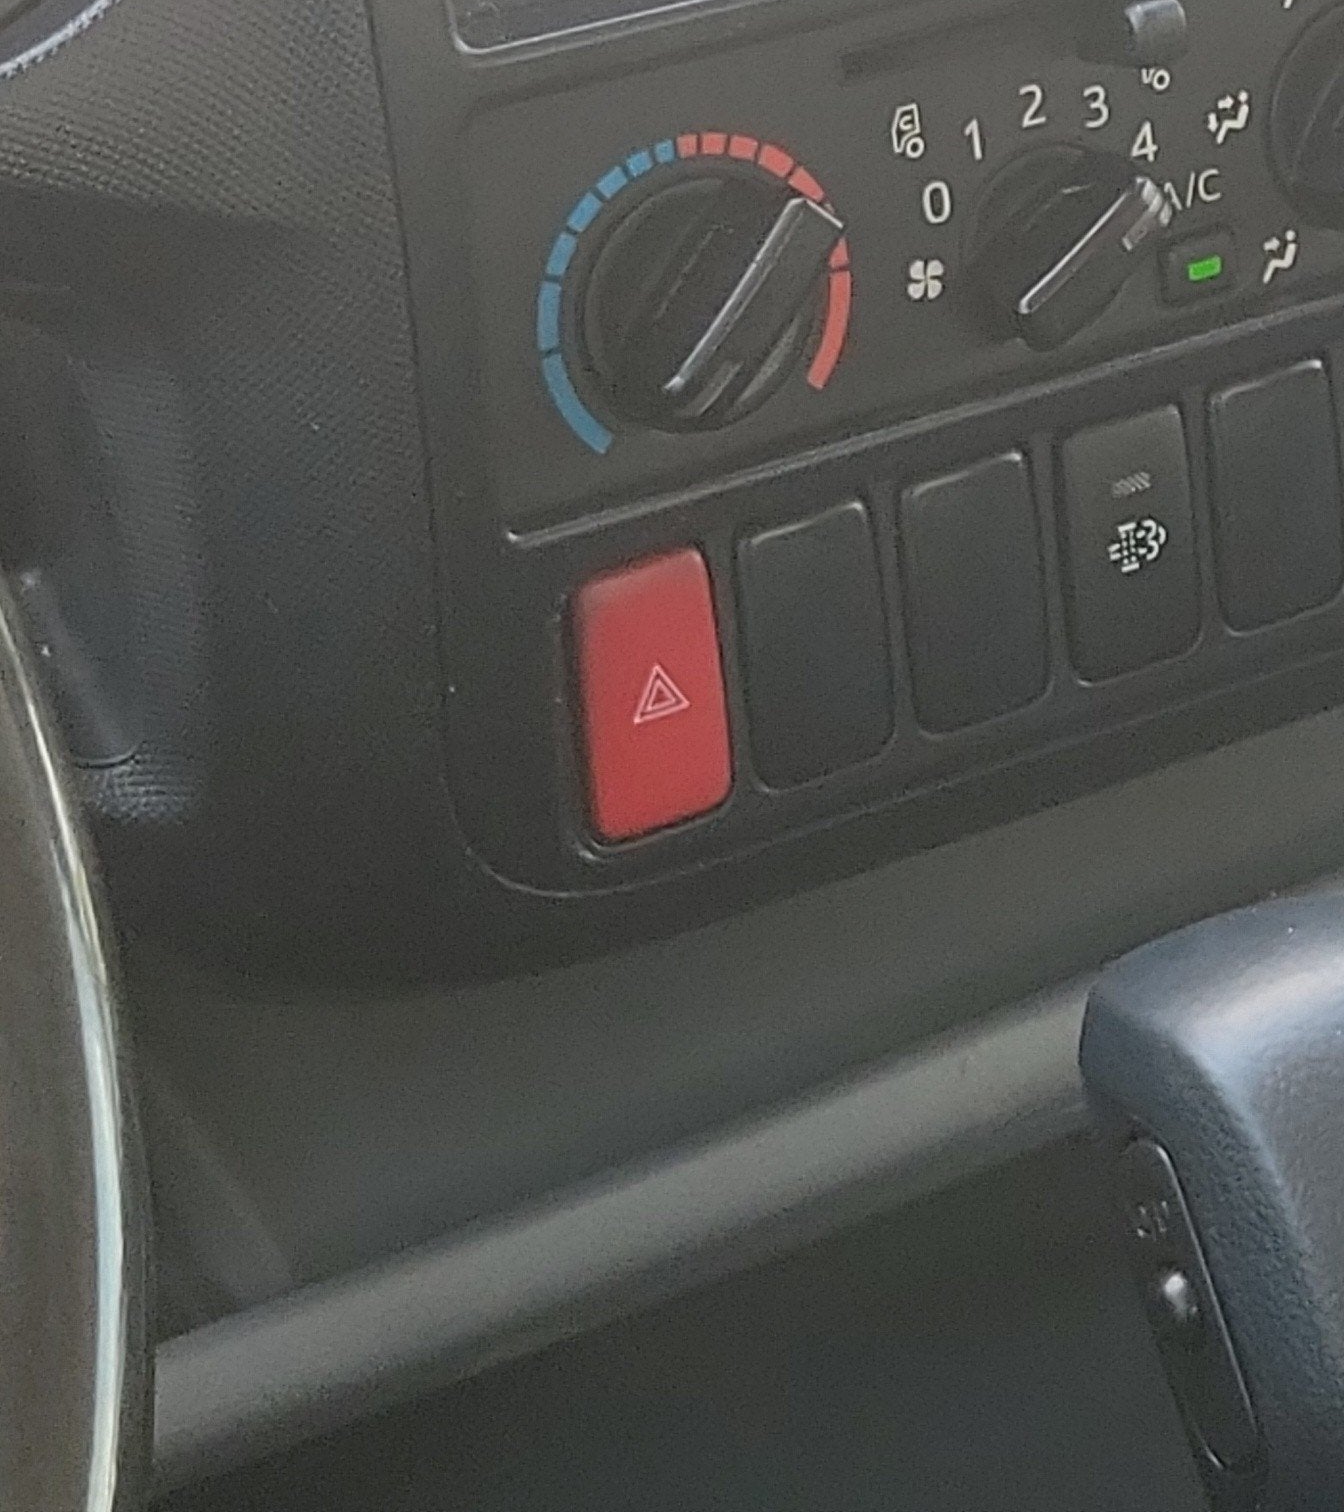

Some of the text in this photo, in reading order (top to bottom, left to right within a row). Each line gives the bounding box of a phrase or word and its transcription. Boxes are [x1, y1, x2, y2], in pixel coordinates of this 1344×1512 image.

[1019, 84, 1048, 127] 2
[1083, 85, 1110, 128] 3
[963, 118, 983, 161] 1
[1130, 120, 1159, 163] 4
[922, 181, 952, 224] 0
